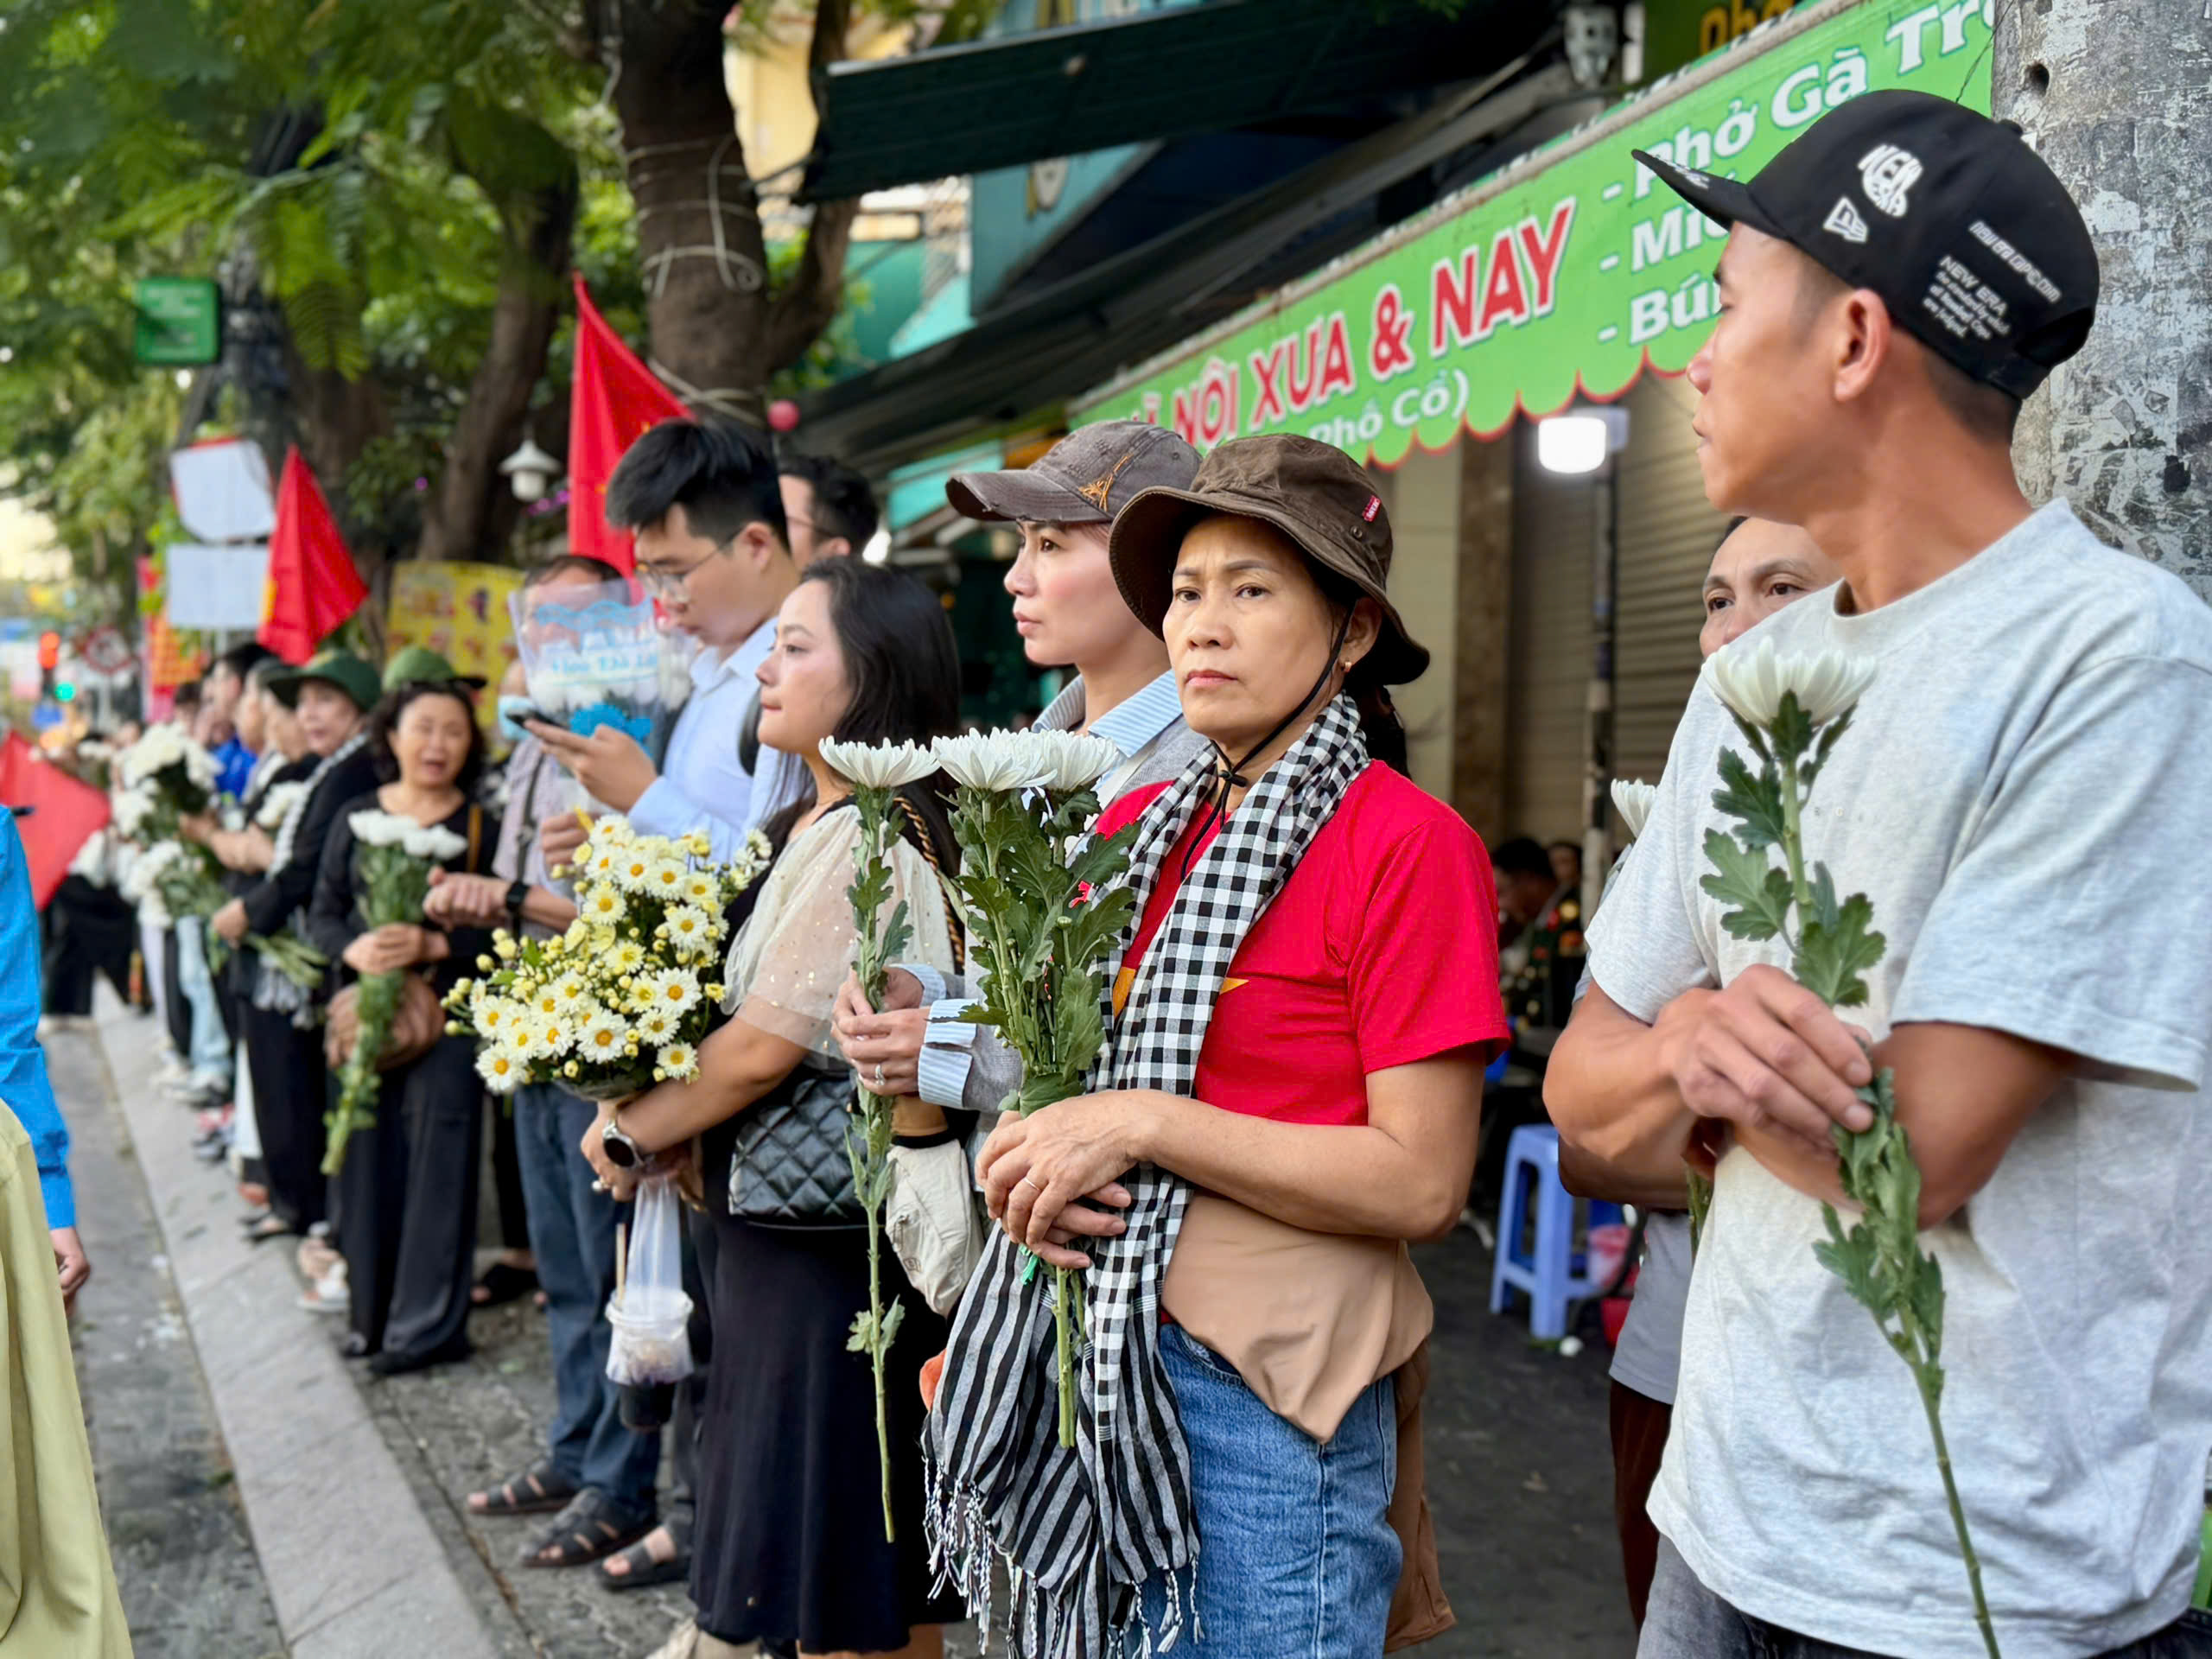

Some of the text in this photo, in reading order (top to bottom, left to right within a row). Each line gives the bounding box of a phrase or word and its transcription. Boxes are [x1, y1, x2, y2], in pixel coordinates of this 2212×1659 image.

[1770, 48, 1867, 128] Gà
[1370, 287, 1414, 380] &
[1431, 197, 1577, 357] NAY
[1939, 255, 2007, 316] NEW ERA
